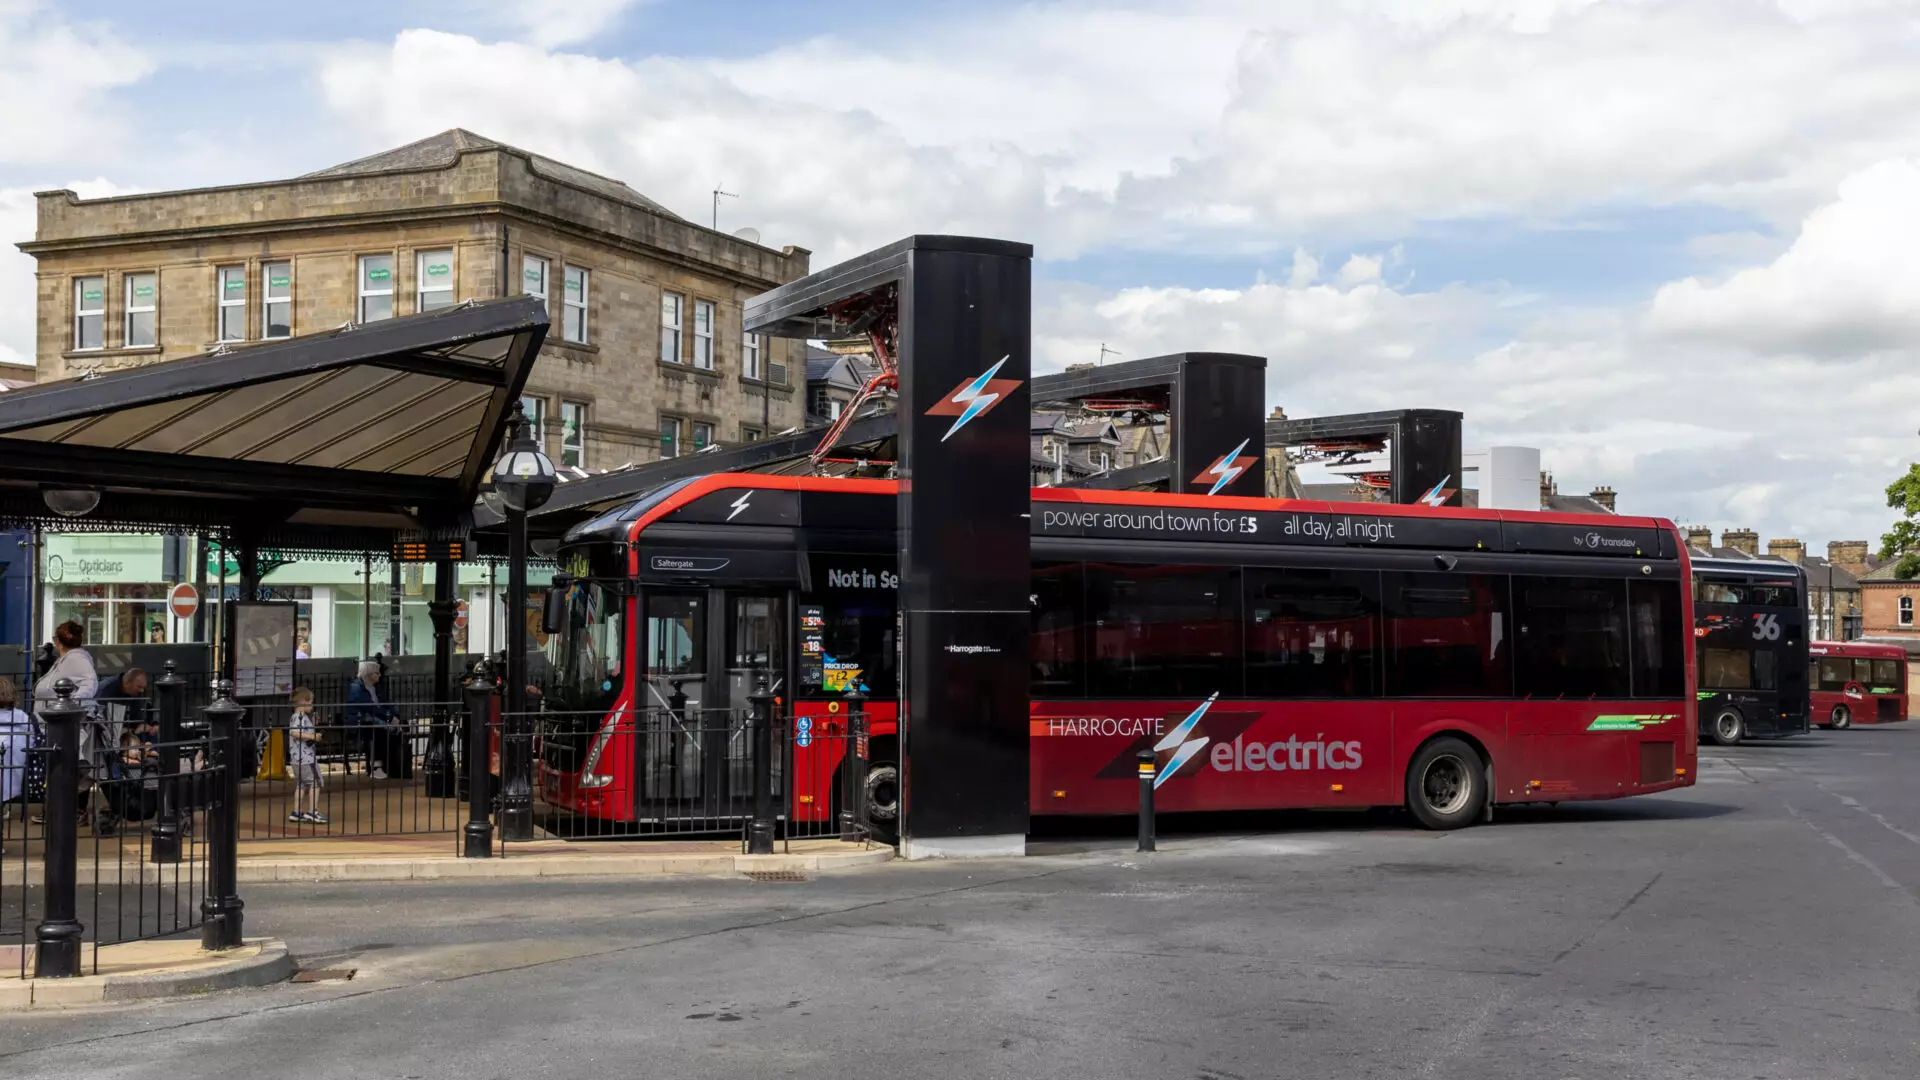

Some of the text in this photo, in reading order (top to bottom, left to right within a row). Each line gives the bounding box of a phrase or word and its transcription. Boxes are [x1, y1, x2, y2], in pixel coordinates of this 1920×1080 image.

[1044, 509, 1258, 534] power around town for £5
[1283, 515, 1396, 542] all day, all night
[1573, 535, 1636, 547] by transdev
[79, 559, 123, 575] Opticians
[657, 558, 694, 569] Saltergate
[828, 568, 859, 588] Not
[862, 568, 876, 589] in
[1752, 613, 1781, 641] 36
[950, 644, 983, 654] Harrogate
[836, 670, 848, 682] £2
[1049, 717, 1165, 736] HARROGATE
[1210, 732, 1363, 773] electrics
